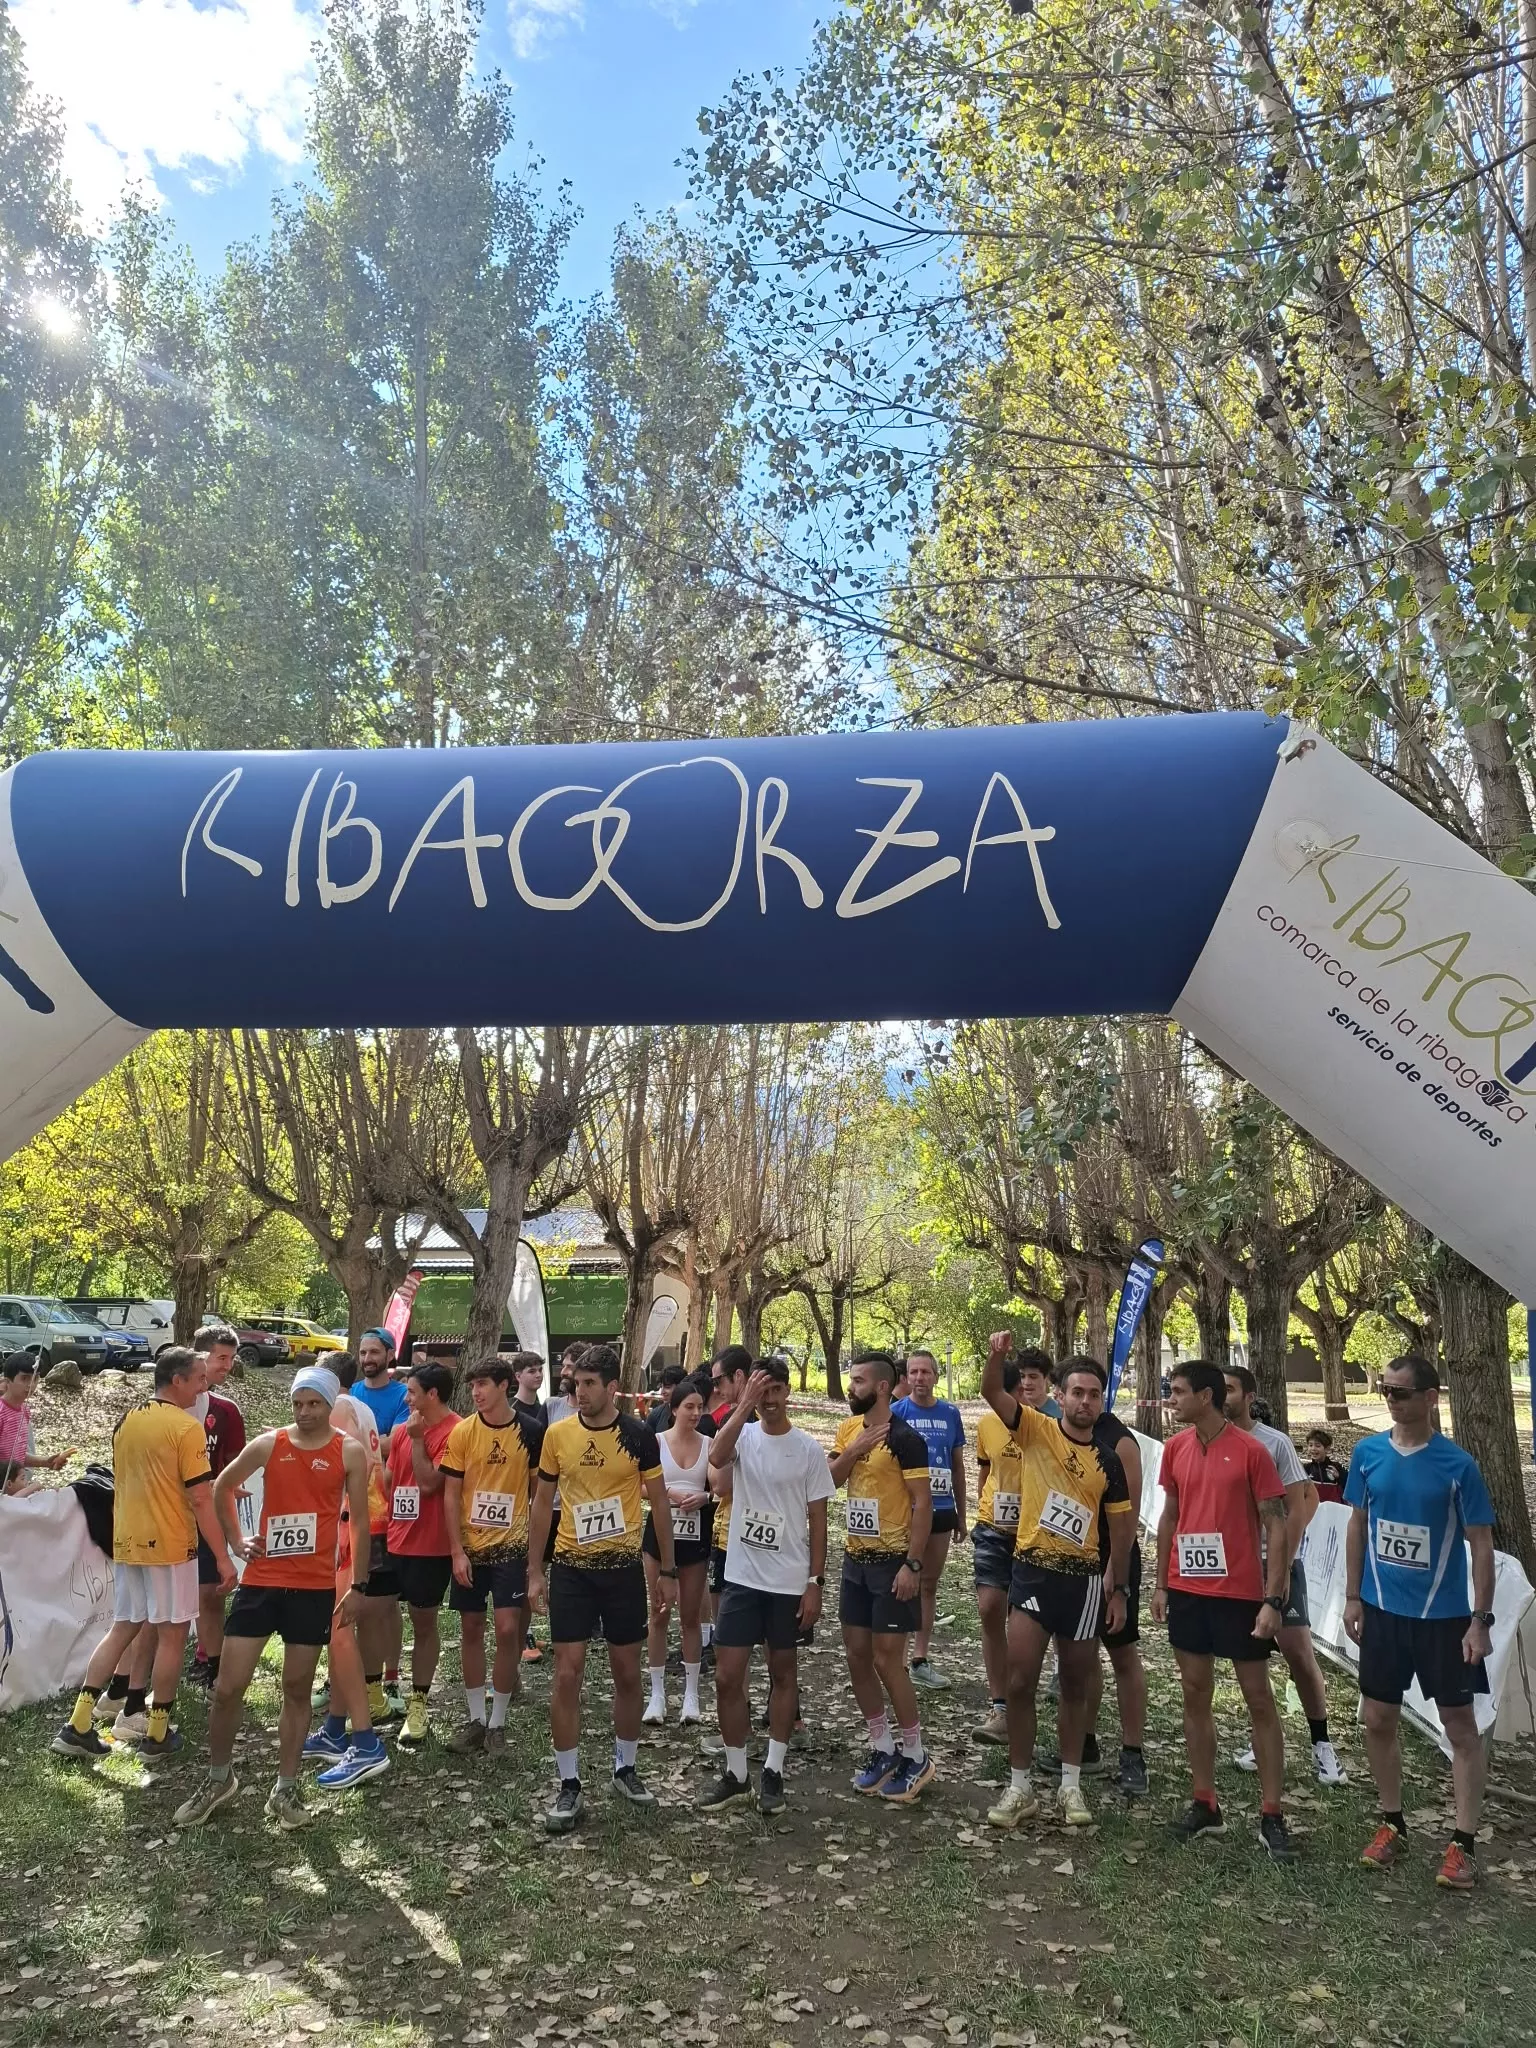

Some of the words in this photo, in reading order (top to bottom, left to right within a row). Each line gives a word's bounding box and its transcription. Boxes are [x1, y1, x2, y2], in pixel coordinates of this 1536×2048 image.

[180, 755, 1062, 931] RIBAGORZA
[1286, 833, 1536, 1096] RIBAG
[1256, 904, 1357, 989] comarca
[1358, 985, 1391, 1015] de
[1390, 1008, 1419, 1037] la
[1416, 1032, 1529, 1124] ribagorza
[1327, 1004, 1394, 1061] servicio
[1395, 1059, 1422, 1083] de
[1422, 1079, 1503, 1148] deportes
[476, 1503, 507, 1521] 764
[580, 1511, 617, 1536] 771
[849, 1511, 875, 1530] 526
[999, 1504, 1020, 1520] 73
[1049, 1505, 1084, 1536] 770
[272, 1528, 309, 1549] 769
[743, 1521, 777, 1545] 749
[1184, 1549, 1219, 1569] 505
[1381, 1535, 1422, 1561] 767
